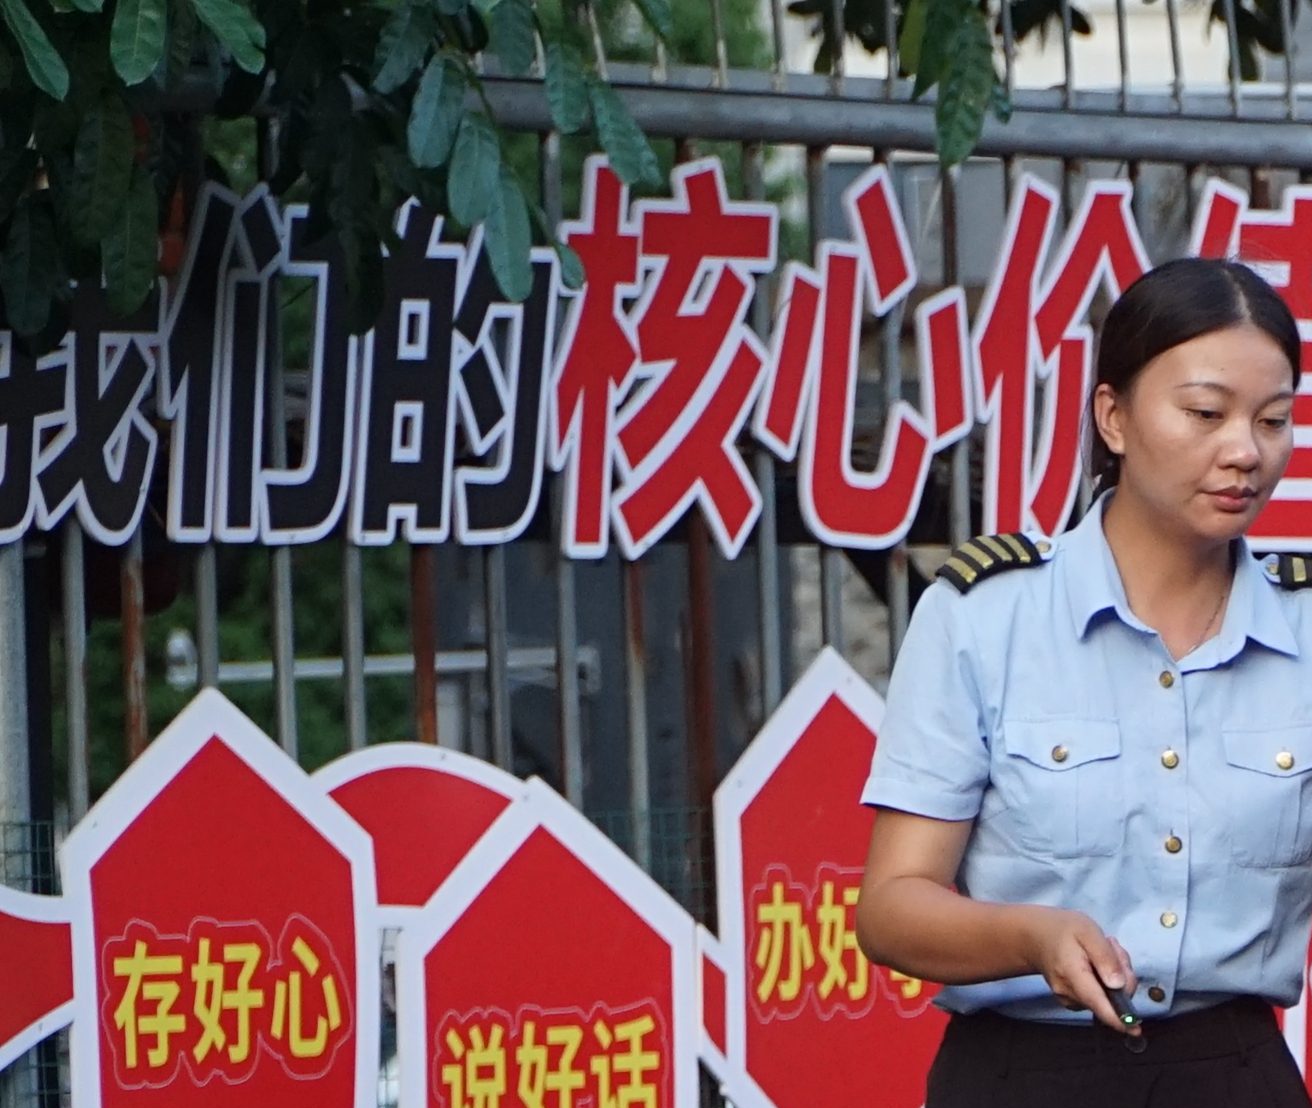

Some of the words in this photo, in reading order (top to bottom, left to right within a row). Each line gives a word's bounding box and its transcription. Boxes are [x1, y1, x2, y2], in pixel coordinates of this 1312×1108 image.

[112, 935, 343, 1071] 存好心
[756, 880, 922, 1003] 办好
